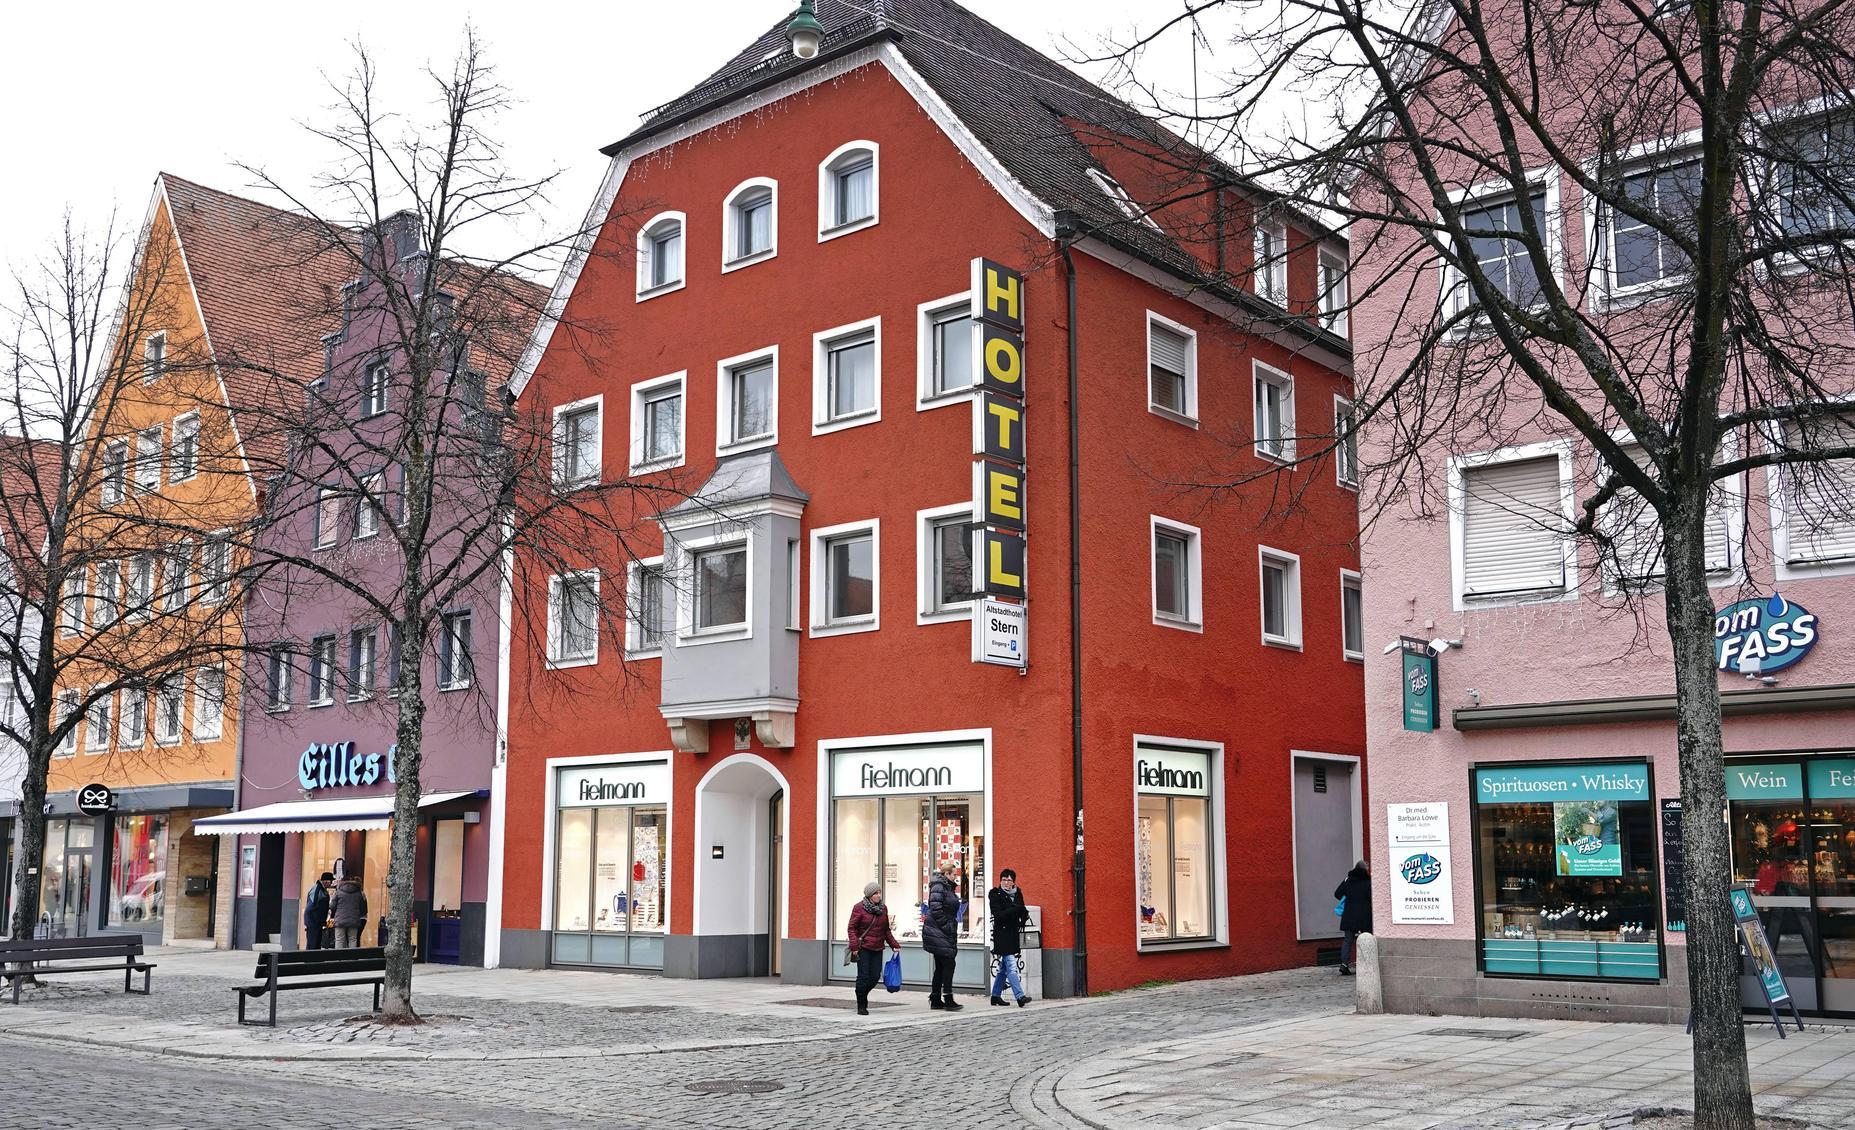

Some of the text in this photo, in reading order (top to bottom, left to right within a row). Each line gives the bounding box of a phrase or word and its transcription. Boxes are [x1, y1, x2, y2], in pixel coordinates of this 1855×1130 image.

[985, 267, 1021, 588] HOTEL
[986, 605, 1022, 618] Altstadthotel
[991, 618, 1018, 635] Stern
[1715, 605, 1759, 637] om
[991, 639, 1007, 648] Eingang
[1719, 614, 1815, 669] FASS
[1411, 674, 1428, 693] FASS
[298, 741, 381, 790] Eilles
[1482, 773, 1645, 797] Spirituosen Whisky
[1738, 771, 1788, 788] Wein
[1573, 837, 1588, 846] vom
[1578, 839, 1602, 854] FASS
[1399, 857, 1421, 872] vom
[1407, 861, 1440, 883] FASS
